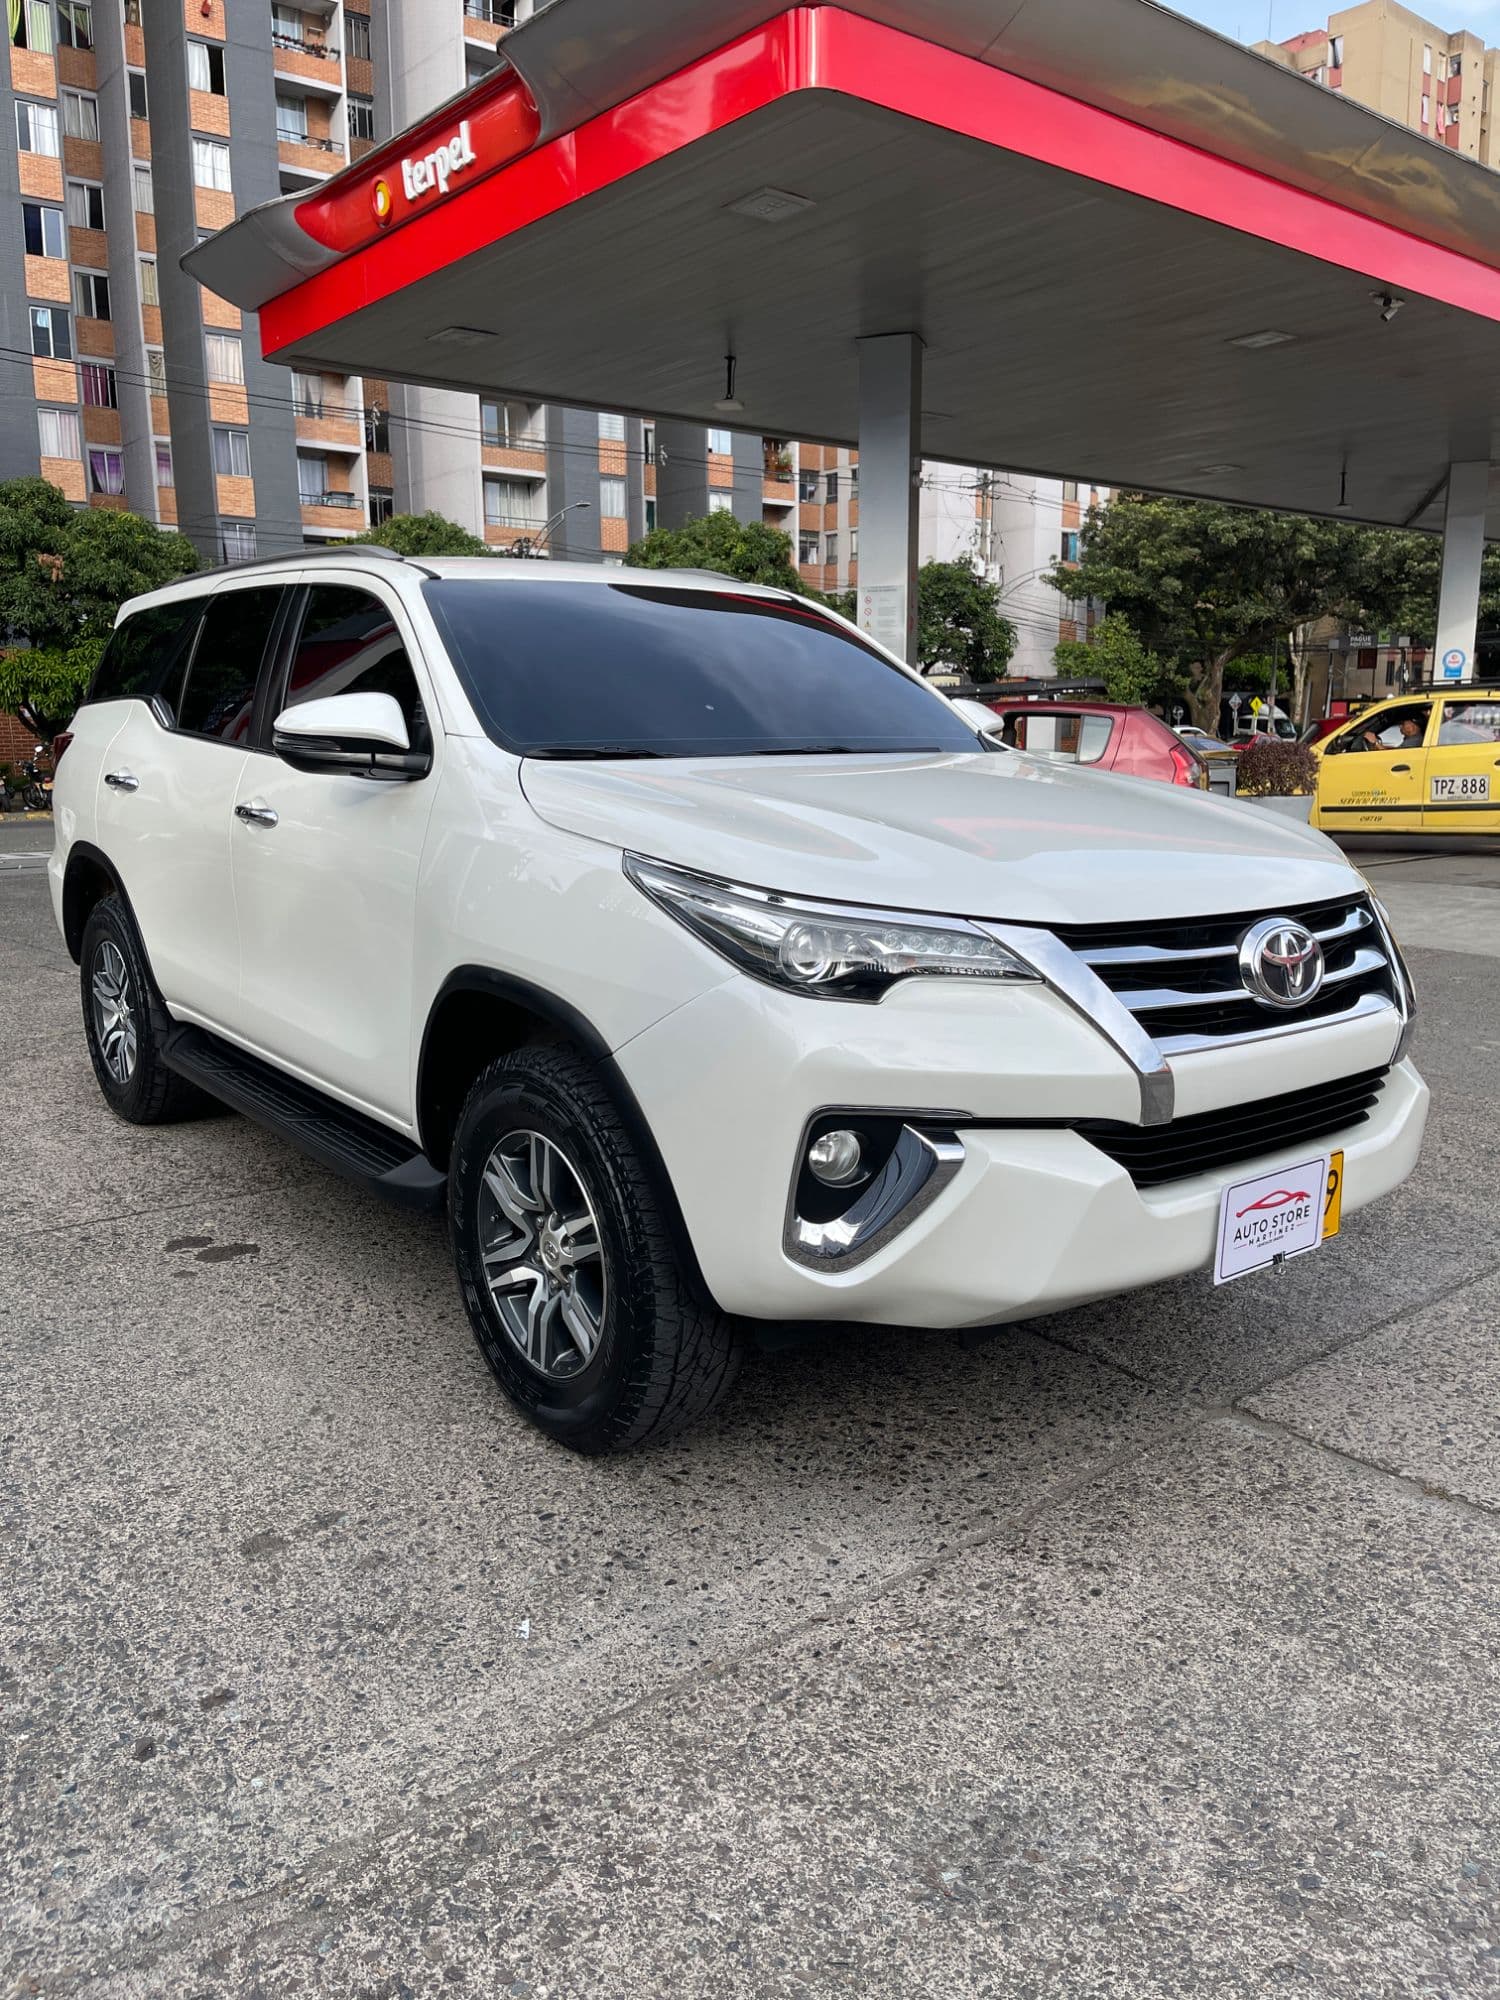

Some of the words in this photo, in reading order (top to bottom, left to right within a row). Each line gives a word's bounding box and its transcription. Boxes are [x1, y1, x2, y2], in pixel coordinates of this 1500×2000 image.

[401, 120, 476, 200] terpel
[1434, 779, 1455, 795] TPZ
[1461, 778, 1486, 794] 888
[1233, 1218, 1268, 1243] AUTO
[1271, 1204, 1310, 1229] STORE
[1248, 1223, 1295, 1246] MARTINEZ
